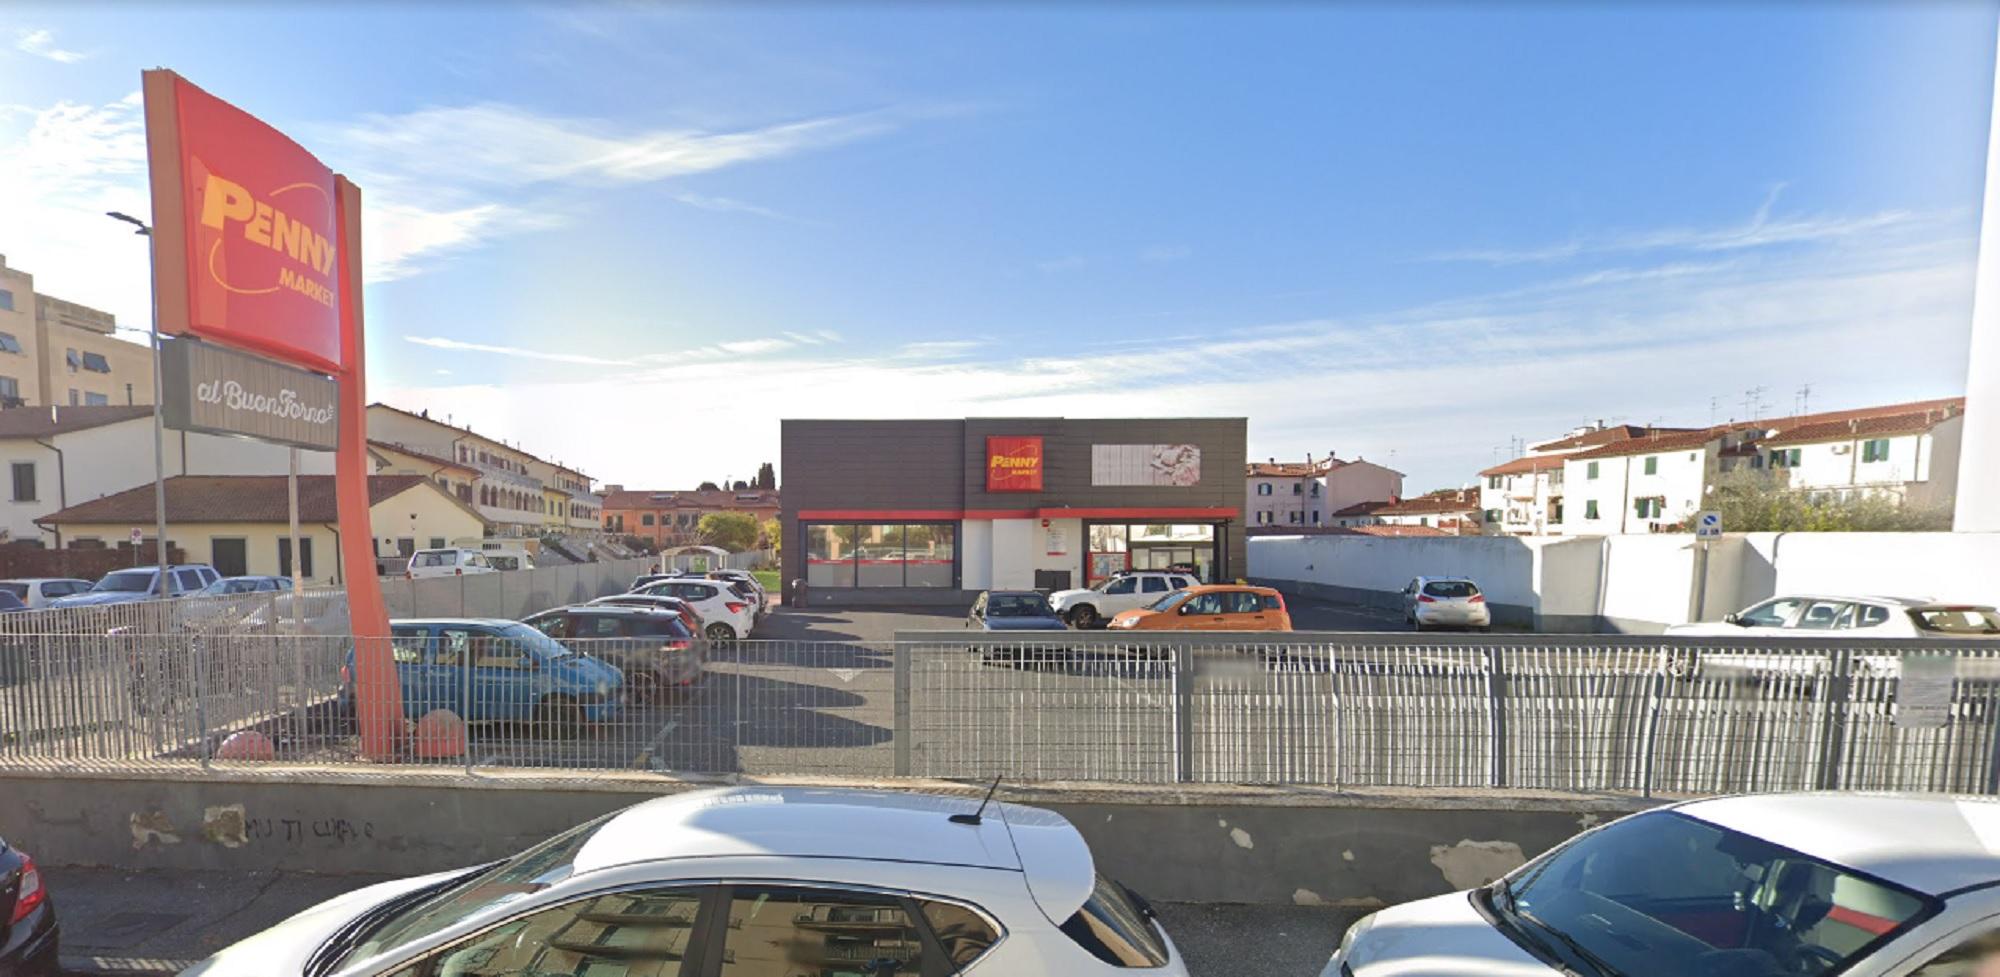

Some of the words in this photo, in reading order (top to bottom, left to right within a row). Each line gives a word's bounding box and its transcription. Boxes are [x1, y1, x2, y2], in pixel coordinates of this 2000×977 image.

[201, 173, 336, 277] PENNY
[279, 266, 334, 309] MARKET
[197, 380, 222, 405] al
[991, 455, 1038, 468] PENNY
